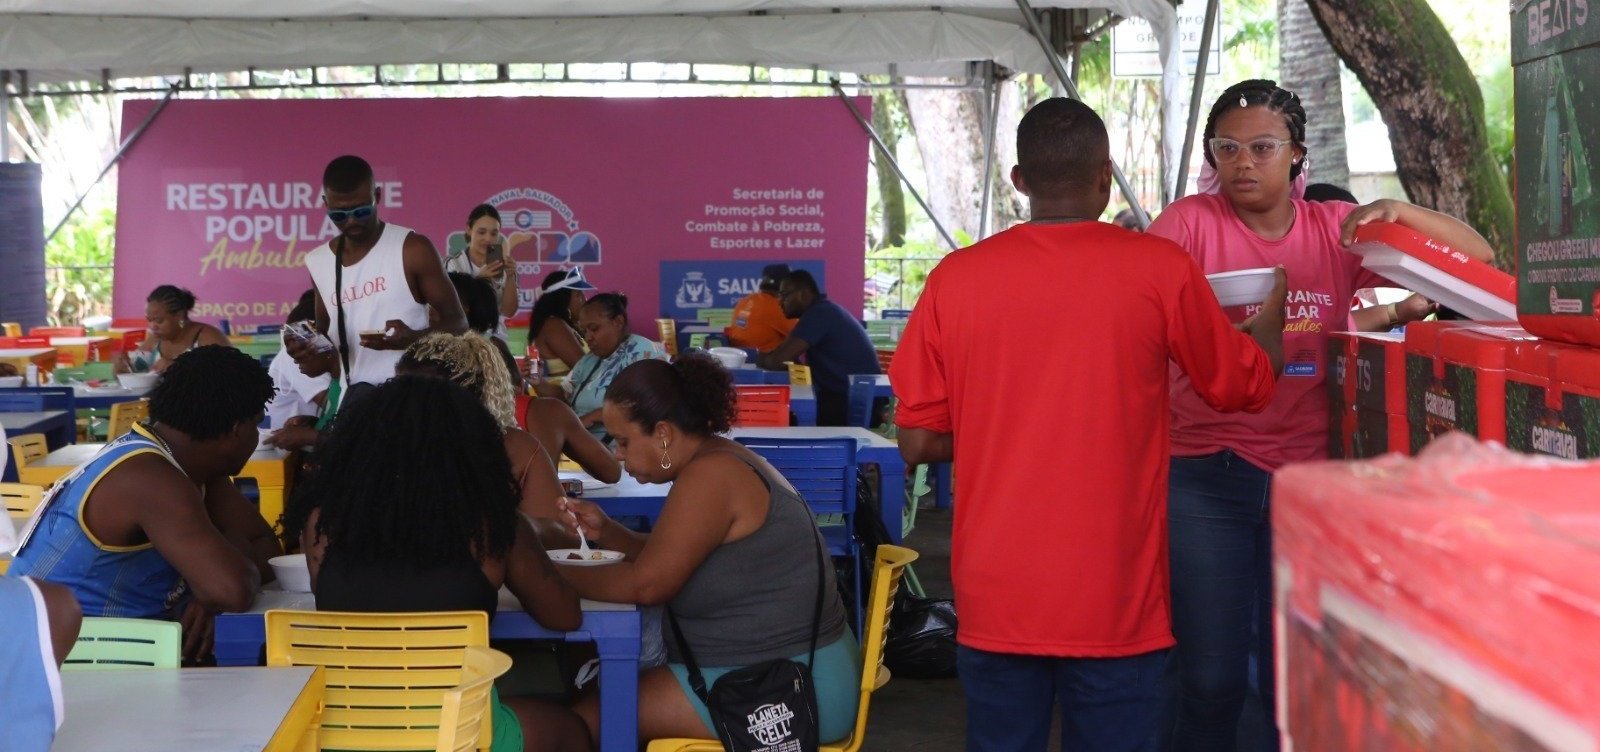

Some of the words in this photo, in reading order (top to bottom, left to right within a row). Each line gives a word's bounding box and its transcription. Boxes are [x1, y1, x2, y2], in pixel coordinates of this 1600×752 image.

[1528, 0, 1588, 46] BEATS
[166, 182, 403, 210] RESTAURE
[524, 187, 573, 219] SALVADOR
[733, 188, 803, 200] Secretaria
[807, 188, 825, 200] de
[705, 204, 775, 216] Promoção
[779, 204, 825, 217] Social,
[206, 214, 344, 242] POPULA
[685, 221, 748, 232] Combate
[752, 221, 760, 232] à
[764, 221, 825, 233] Pobreza,
[710, 237, 770, 250] Esportes
[774, 239, 782, 248] e
[787, 237, 825, 248] Lazer
[1527, 241, 1559, 262] CHEGOU
[1560, 239, 1589, 260] GREEN
[200, 236, 306, 277] Ambula
[331, 276, 386, 307] CALOR
[718, 278, 763, 295] SALV
[190, 302, 249, 320] SPAÇO
[253, 303, 276, 316] DE
[1246, 305, 1319, 319] POLAR
[1337, 356, 1371, 392] BTS
[747, 702, 789, 726] PLANETA
[758, 720, 792, 745] CELL
